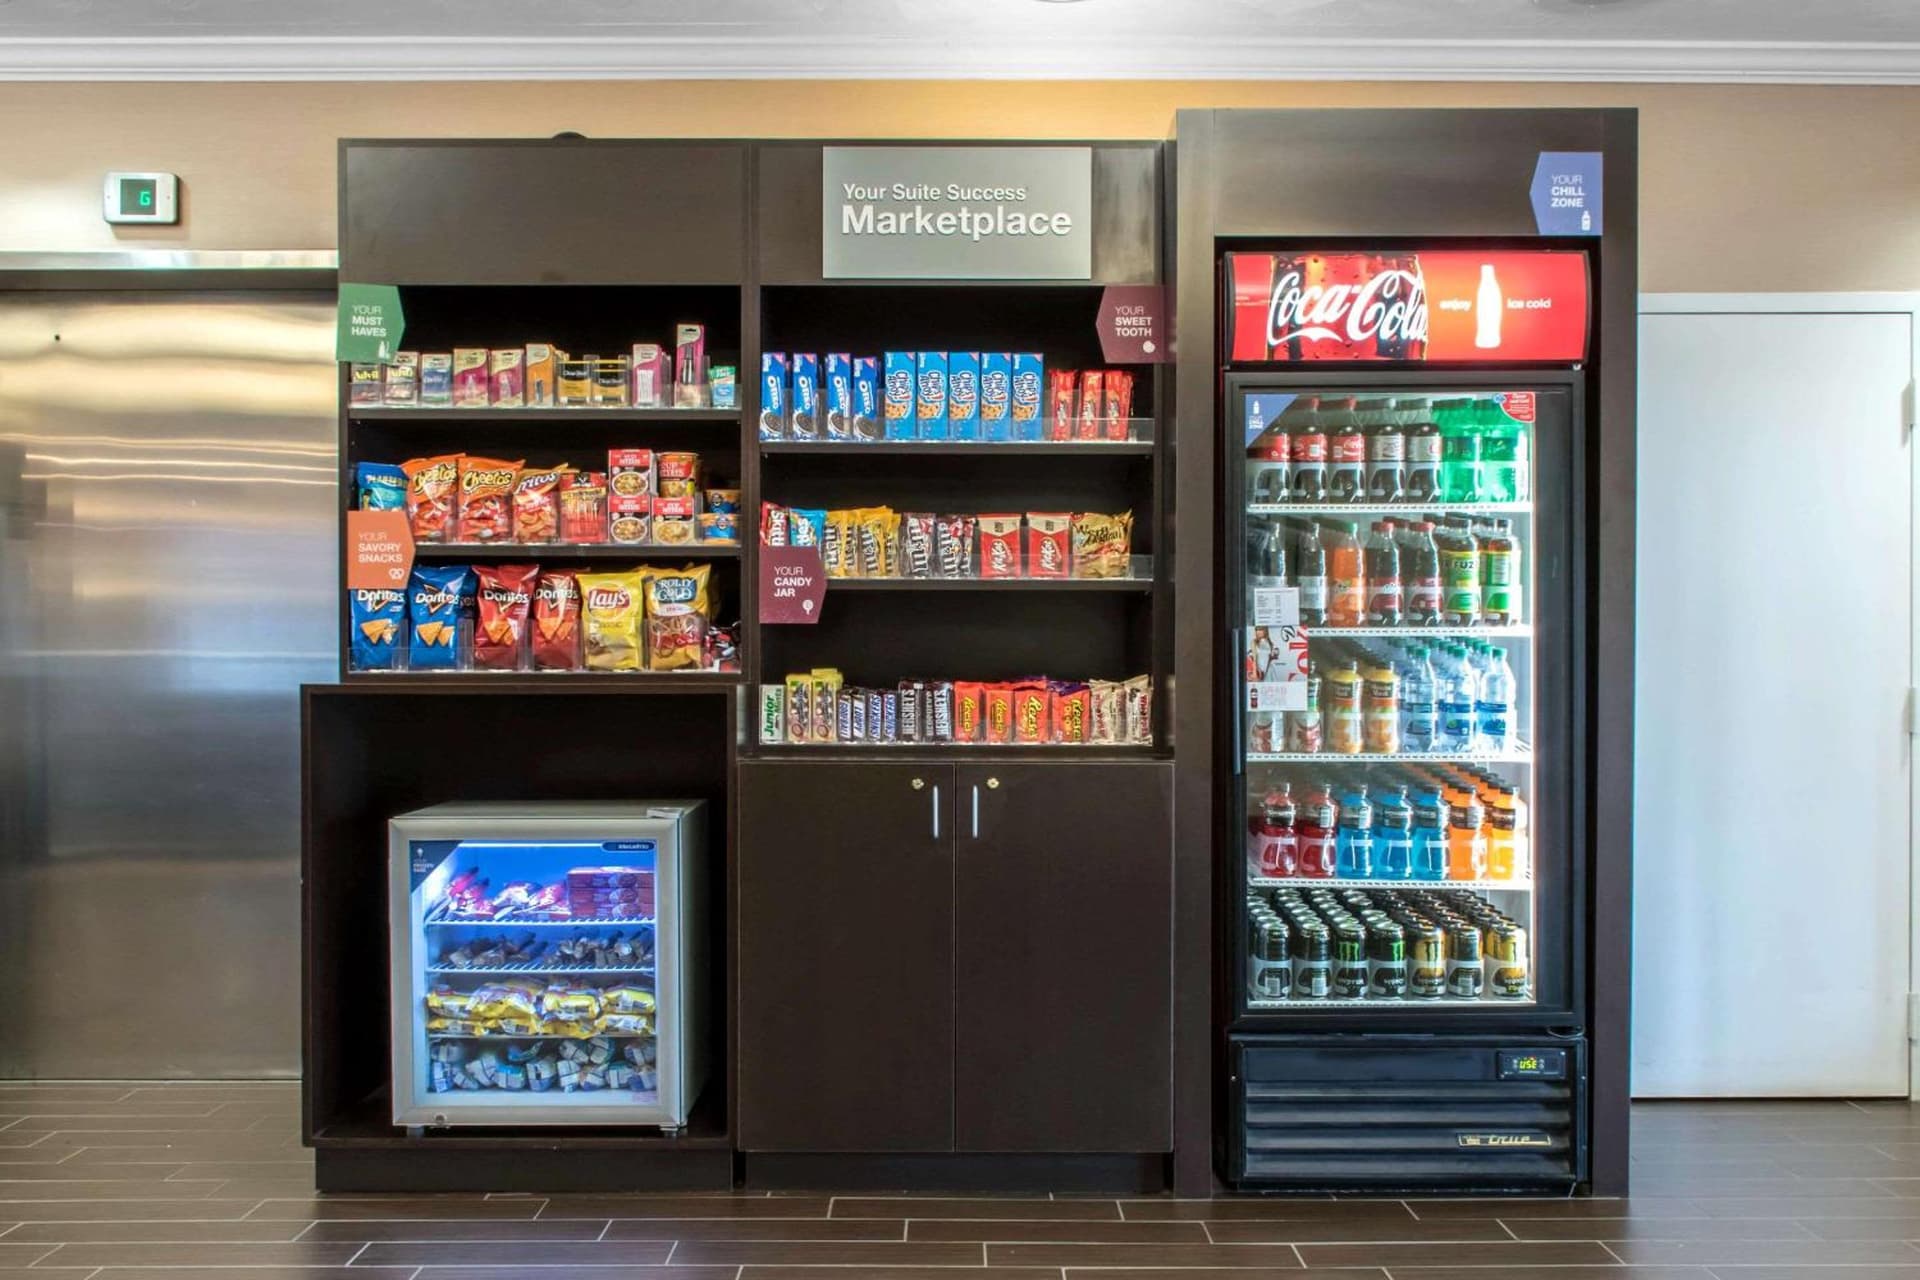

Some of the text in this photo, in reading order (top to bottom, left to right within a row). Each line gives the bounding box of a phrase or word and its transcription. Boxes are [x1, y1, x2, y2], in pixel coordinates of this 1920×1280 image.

[1551, 174, 1583, 185] YOUR
[843, 183, 1027, 201] Your Suite Success
[1551, 186, 1585, 196] CHILL
[1551, 197, 1584, 208] ZONE
[841, 204, 1073, 242] Marketplace
[1266, 268, 1429, 347] Coca-Cola
[1439, 298, 1471, 312] enjoy
[1526, 298, 1552, 309] cold
[352, 305, 382, 315] YOUR
[1114, 305, 1144, 315] YOUR
[352, 315, 383, 326] MUST
[1114, 316, 1152, 326] SWEET
[351, 326, 387, 337] HAVES
[1114, 327, 1152, 337] TOOTH
[413, 463, 457, 494] Cheetos
[462, 470, 514, 494] Cheetos
[358, 531, 387, 541] YOUR
[358, 543, 402, 553] SAVORY
[358, 553, 403, 563] SNACKS
[774, 566, 804, 576] YOUR
[774, 577, 813, 587] CANDY
[357, 589, 405, 605] Doritos
[483, 589, 529, 604] Doritos
[535, 588, 579, 602] Doritos
[774, 587, 796, 597] JAR
[415, 592, 460, 606] Doritos
[588, 588, 630, 610] Lay's
[764, 695, 775, 737] Junior
